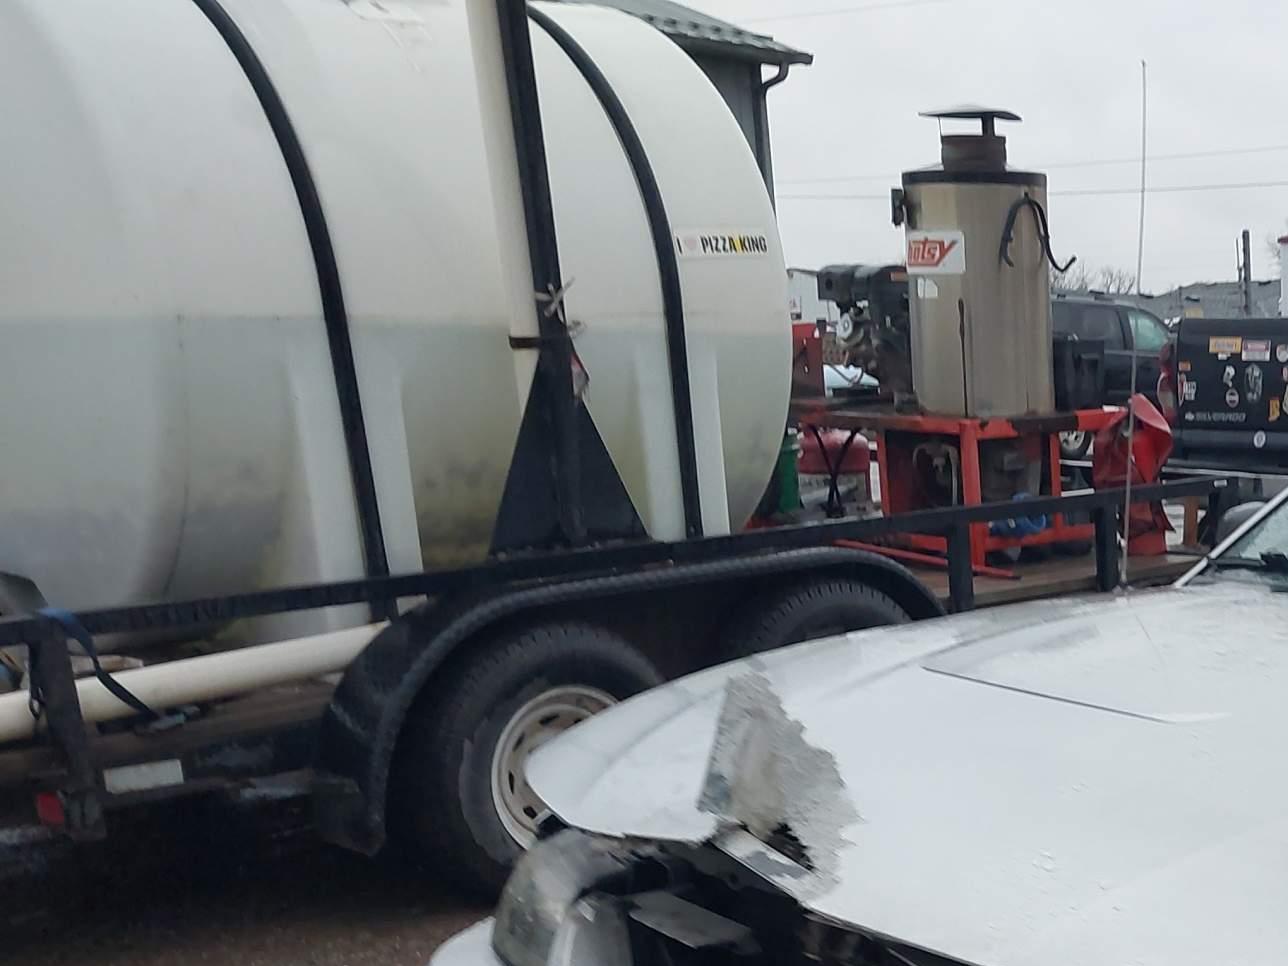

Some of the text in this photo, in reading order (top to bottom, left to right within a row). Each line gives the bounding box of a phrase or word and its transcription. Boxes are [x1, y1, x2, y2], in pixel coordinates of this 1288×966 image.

[675, 234, 768, 254] I PIZZA KING
